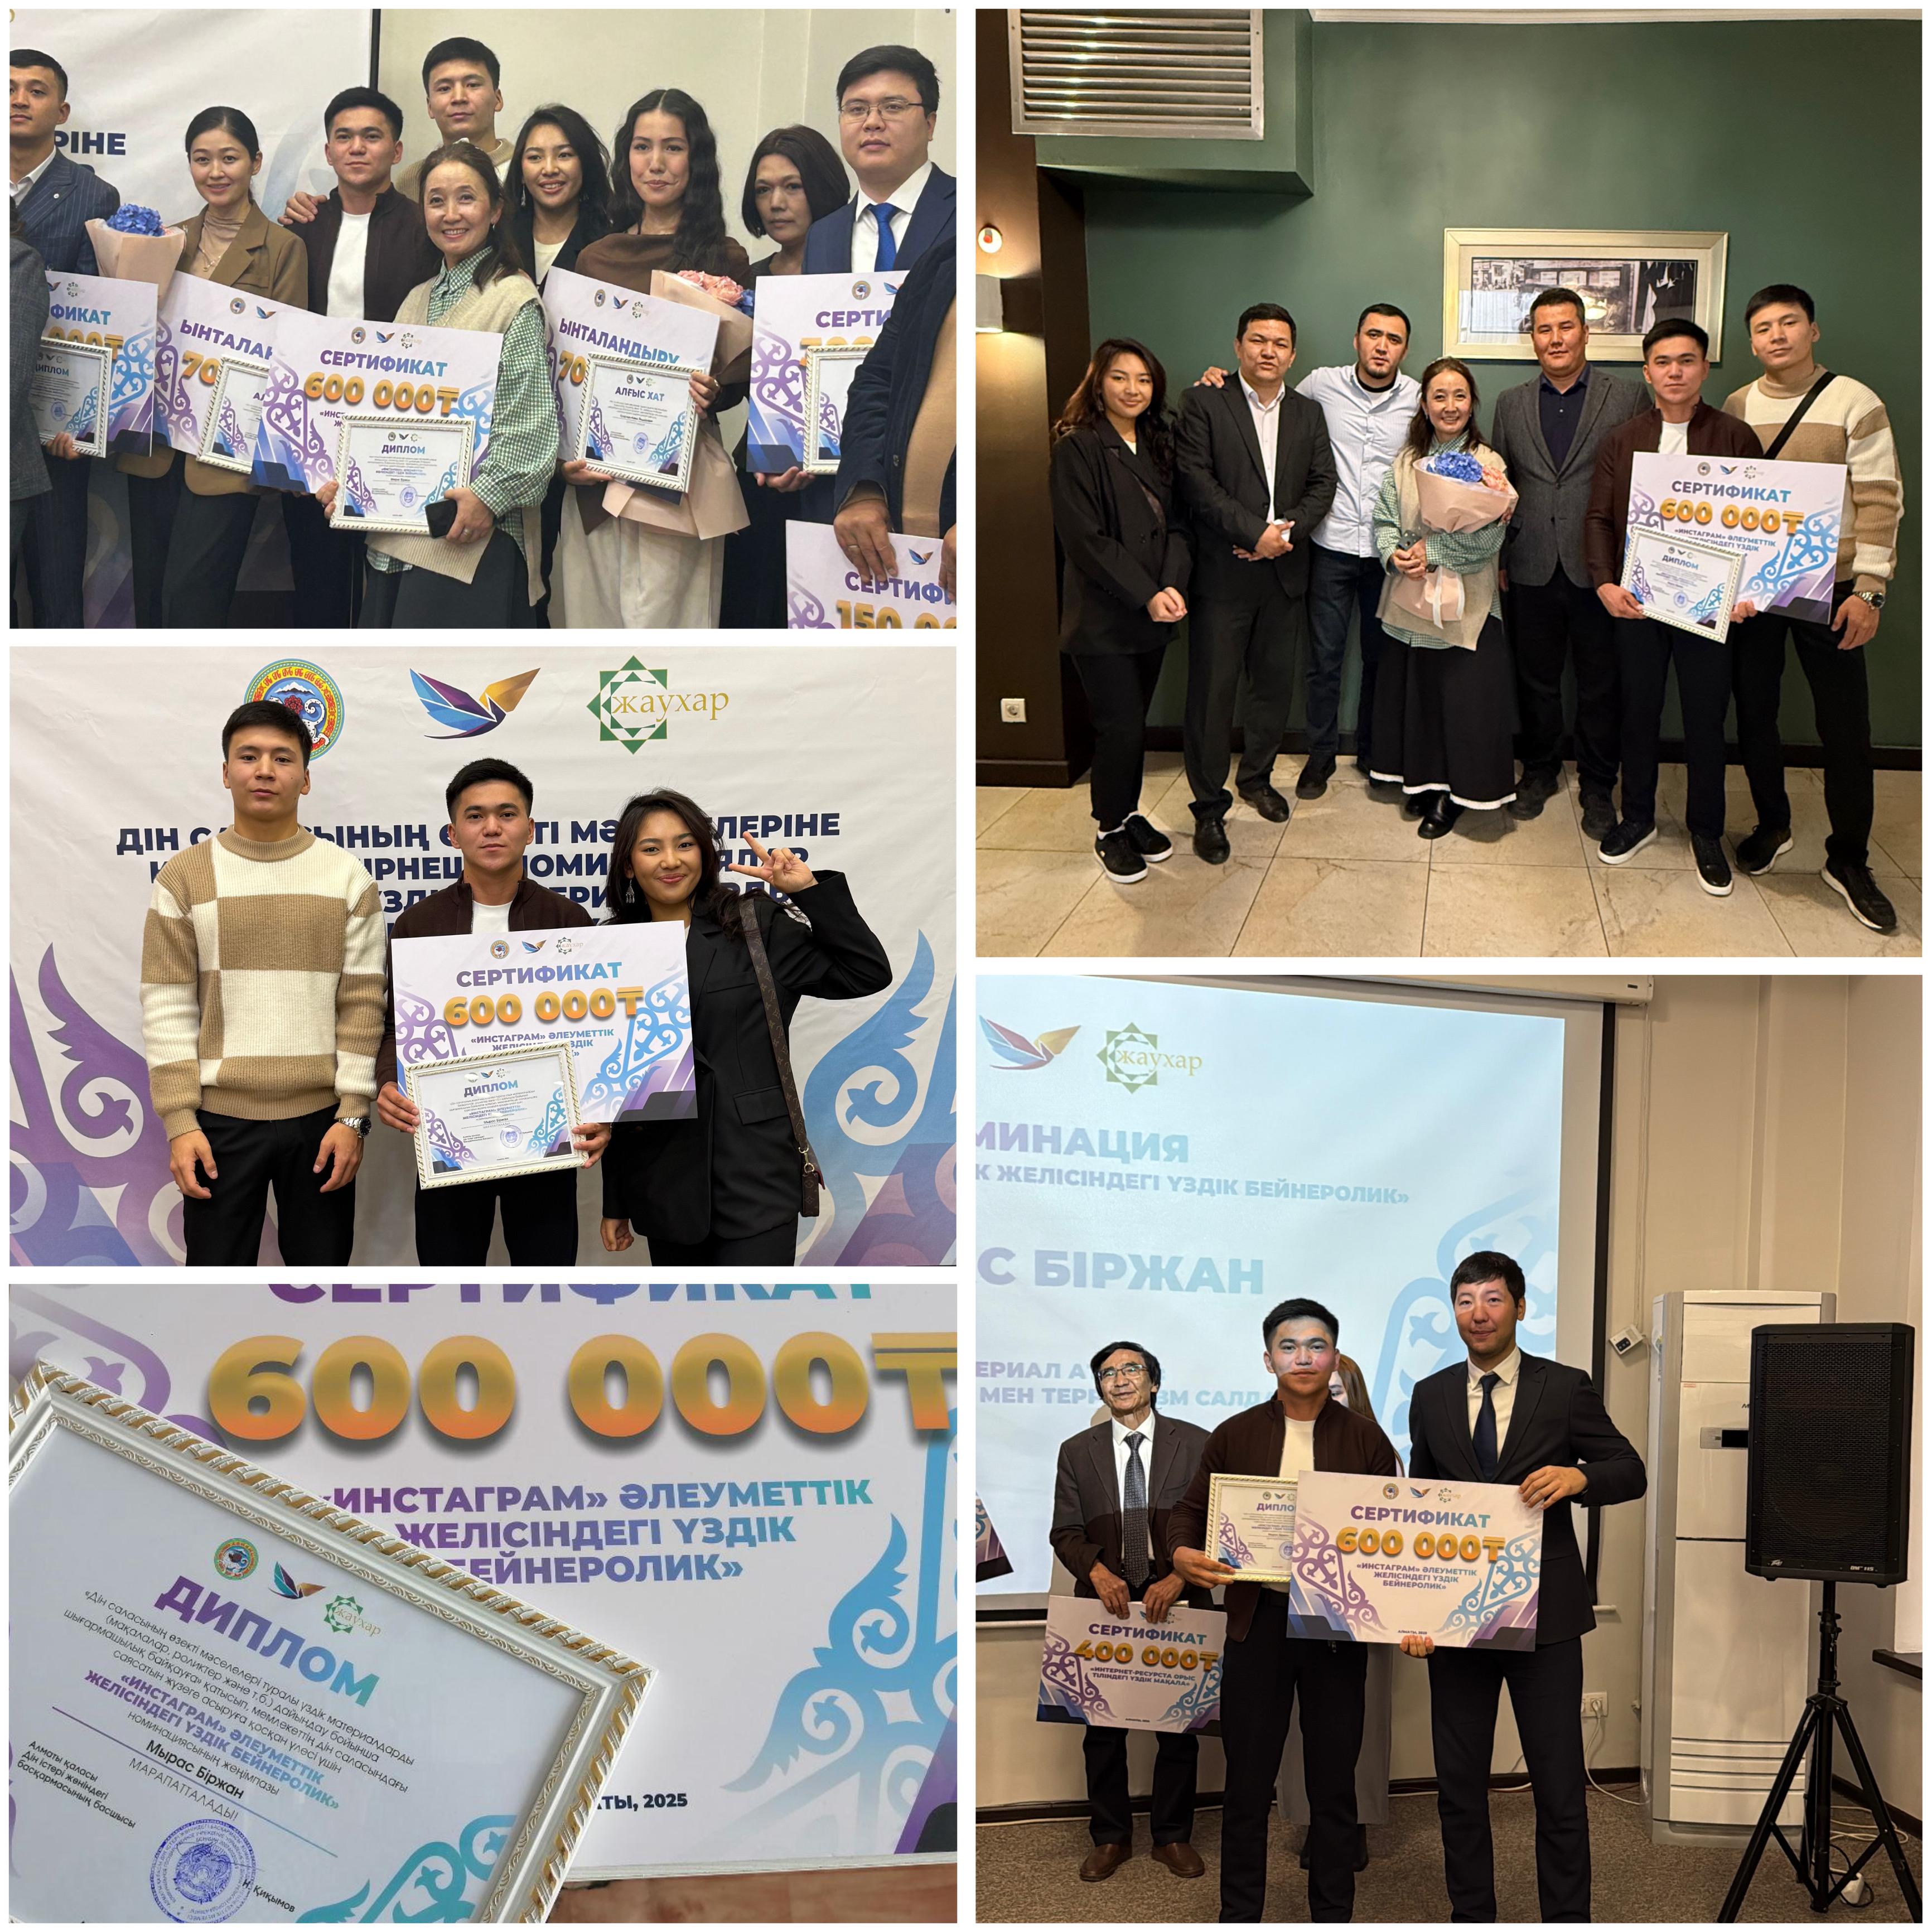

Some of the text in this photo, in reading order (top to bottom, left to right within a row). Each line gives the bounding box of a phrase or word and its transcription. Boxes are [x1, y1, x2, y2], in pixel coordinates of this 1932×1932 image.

[54, 130, 126, 156] РІНЕ
[50, 303, 112, 326] ФИКАТ
[815, 310, 892, 329] СЕРТИ
[320, 349, 448, 378] СЕРТИФИКАТ
[304, 371, 365, 404] 600
[615, 387, 665, 402] АЛҒЫС ХАТ
[381, 445, 426, 455] ДИПЛОМ
[1671, 480, 1791, 503] СЕРТИФИКАТ
[1660, 498, 1713, 524] 600
[1674, 528, 1776, 547] «ИНСТАГРАМ» ӘЛЕУМЕТТІК
[1736, 543, 1760, 552] ҮЗДІК
[1662, 554, 1699, 570] ДИПЛОМ
[845, 571, 957, 606] СЕРТИФ
[612, 692, 730, 723] жаухар
[116, 828, 179, 856] ДІН
[456, 961, 622, 988] СЕРТИФИКАТ
[444, 992, 522, 1026] 600
[471, 1029, 614, 1044] «ИНСТАГРАМ» ӘЛЕУМЕТТІК
[569, 1039, 594, 1049] ЗДІК
[1115, 1049, 1202, 1076] жаухар
[463, 1079, 519, 1098] ДИПЛОМ
[976, 1121, 1189, 1164] МИНАЦИЯ
[997, 1165, 1160, 1191] ЖЕЛІСІНДЕГІ
[1167, 1176, 1238, 1197] ҮЗДІК
[1245, 1178, 1410, 1205] БЕЙНЕРОЛИК»
[1034, 1249, 1264, 1295] БІРЖАН
[976, 1361, 1062, 1379] ЕРИАЛ
[207, 1335, 518, 1441] 600
[980, 1387, 1035, 1404] МЕН
[322, 1480, 873, 1514] «ИНСТАГРАМ» ӘЛЕУМЕТТІК
[1256, 1503, 1295, 1511] ДИПЛО
[1350, 1505, 1491, 1529] СЕРТИФИКАТ
[394, 1516, 796, 1552] ЖЕЛІСІНДЕГІ ҮЗДІК
[1336, 1526, 1404, 1556] 600
[1356, 1562, 1477, 1576] «ИНСТАГРАМ» ӘЛЕУМЕТТІК
[1374, 1571, 1431, 1582] ЖЕЛІСІНДЕГІ
[1383, 1580, 1446, 1589] БЕЙНЕРОЛИК»
[335, 1607, 381, 1637] жаухар
[1089, 1623, 1207, 1645] СЕРТИФИКАТ
[153, 1575, 380, 1707] ДИПЛОМ
[1074, 1639, 1133, 1663] 400
[85, 1590, 415, 1766] «Дін саласының өзекті мәселелері туралы үздік материалдарды
[105, 1615, 171, 1656] (мақалалар,
[172, 1650, 223, 1681] роликтер
[224, 1676, 250, 1695] және
[273, 1704, 330, 1736] дайындау
[330, 1729, 380, 1762] бойынша
[1092, 1672, 1128, 1680] ТІЛІНДЕГІ
[64, 1609, 409, 1794] шығармашылық байқауға» қатысып, мемлекеттің дін саласындағы
[113, 1649, 342, 1774] саясатын жүзеге асыруға қосқан үлесі үшін
[84, 1669, 339, 1809] ЖЕЛІСІНДЕГІ ҮЗДІК БЕЙНЕРОЛИК»
[120, 1674, 325, 1785] «ИНСТАГРАМ» ӘЛЕУМЕТТІК
[28, 1740, 99, 1783] Алматы қаласы
[127, 1711, 280, 1796] номинациясының жеңімпазы
[21, 1750, 109, 1800] Дін істері жөніндегі
[145, 1739, 245, 1800] Мырас Біржан
[16, 1759, 137, 1829] басқармасының басшысы
[128, 1757, 239, 1822] МАРАПАТТАЛАДЫ!
[643, 1793, 688, 1808] 2025
[253, 1886, 296, 1913] Қиқымов
